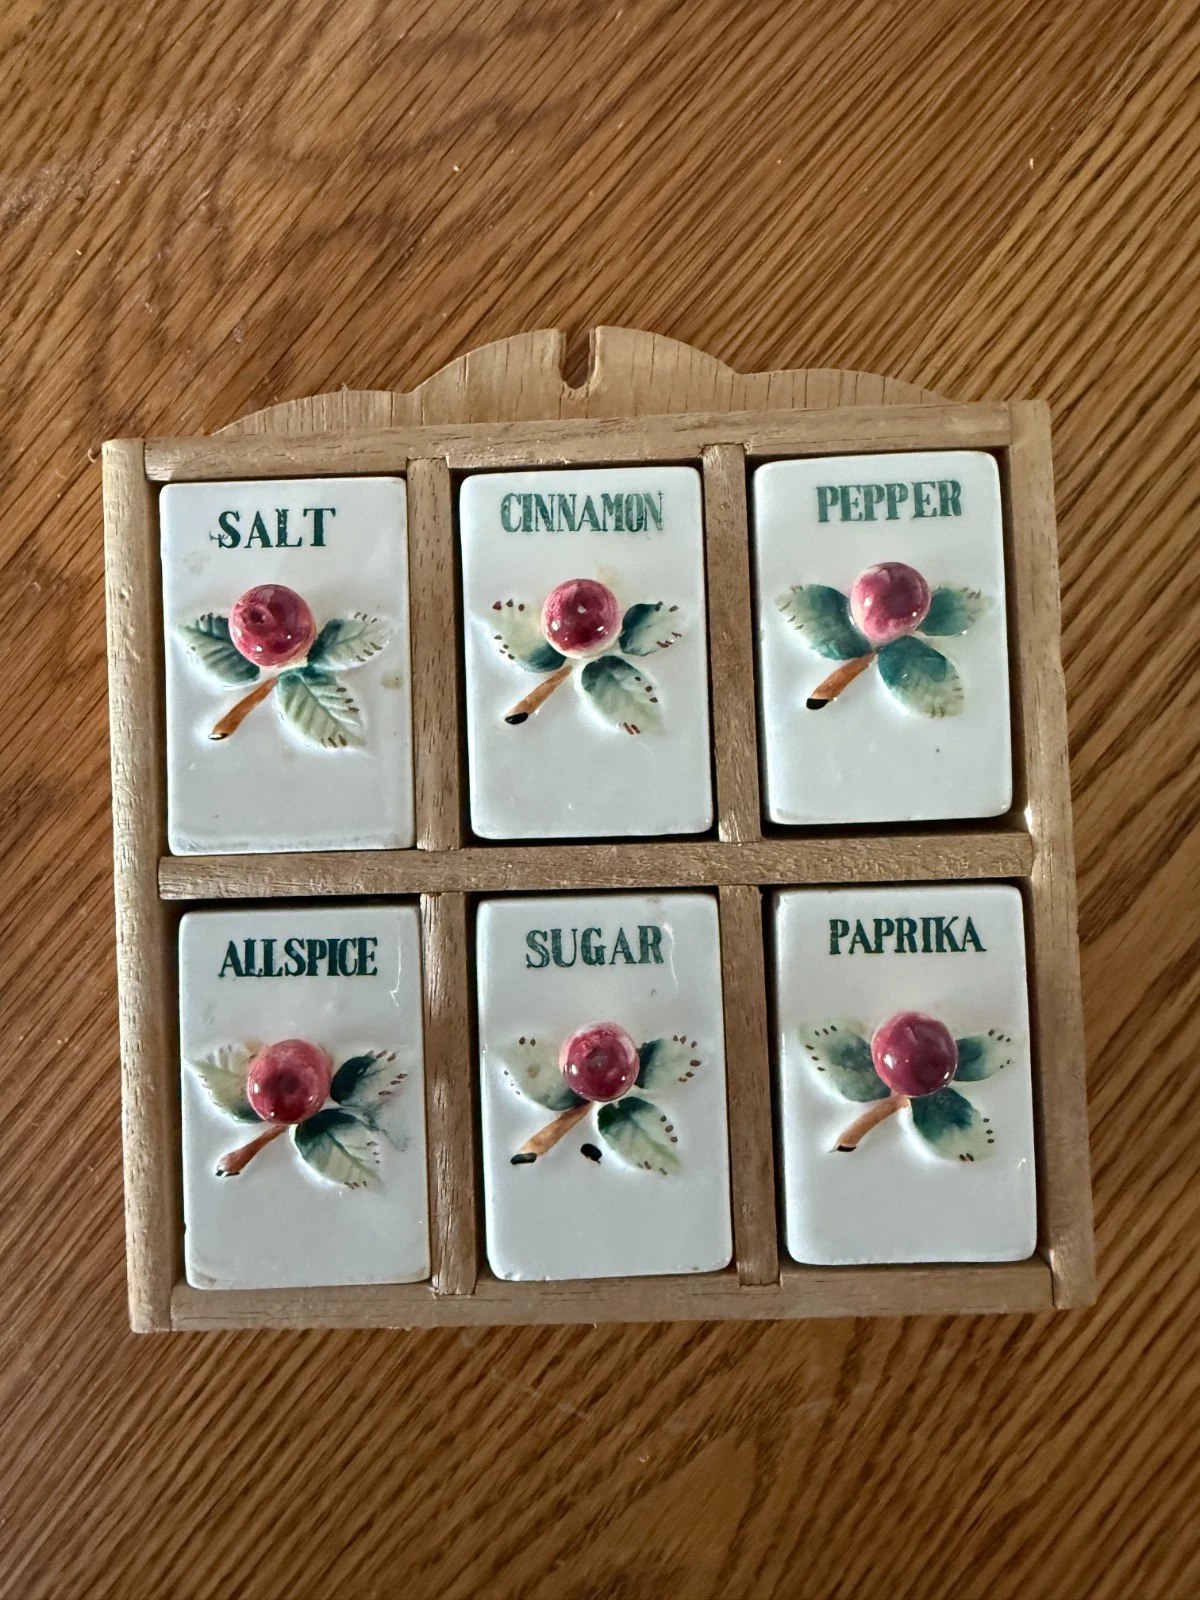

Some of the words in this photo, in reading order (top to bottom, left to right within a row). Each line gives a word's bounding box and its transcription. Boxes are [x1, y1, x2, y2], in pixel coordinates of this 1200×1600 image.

[500, 490, 664, 533] CINNAMON
[815, 479, 962, 523] PEPPER
[217, 507, 336, 548] SALT
[525, 925, 664, 969] SUGAR
[828, 915, 987, 955] PAPRIKA
[218, 936, 379, 978] ALLSPICE
